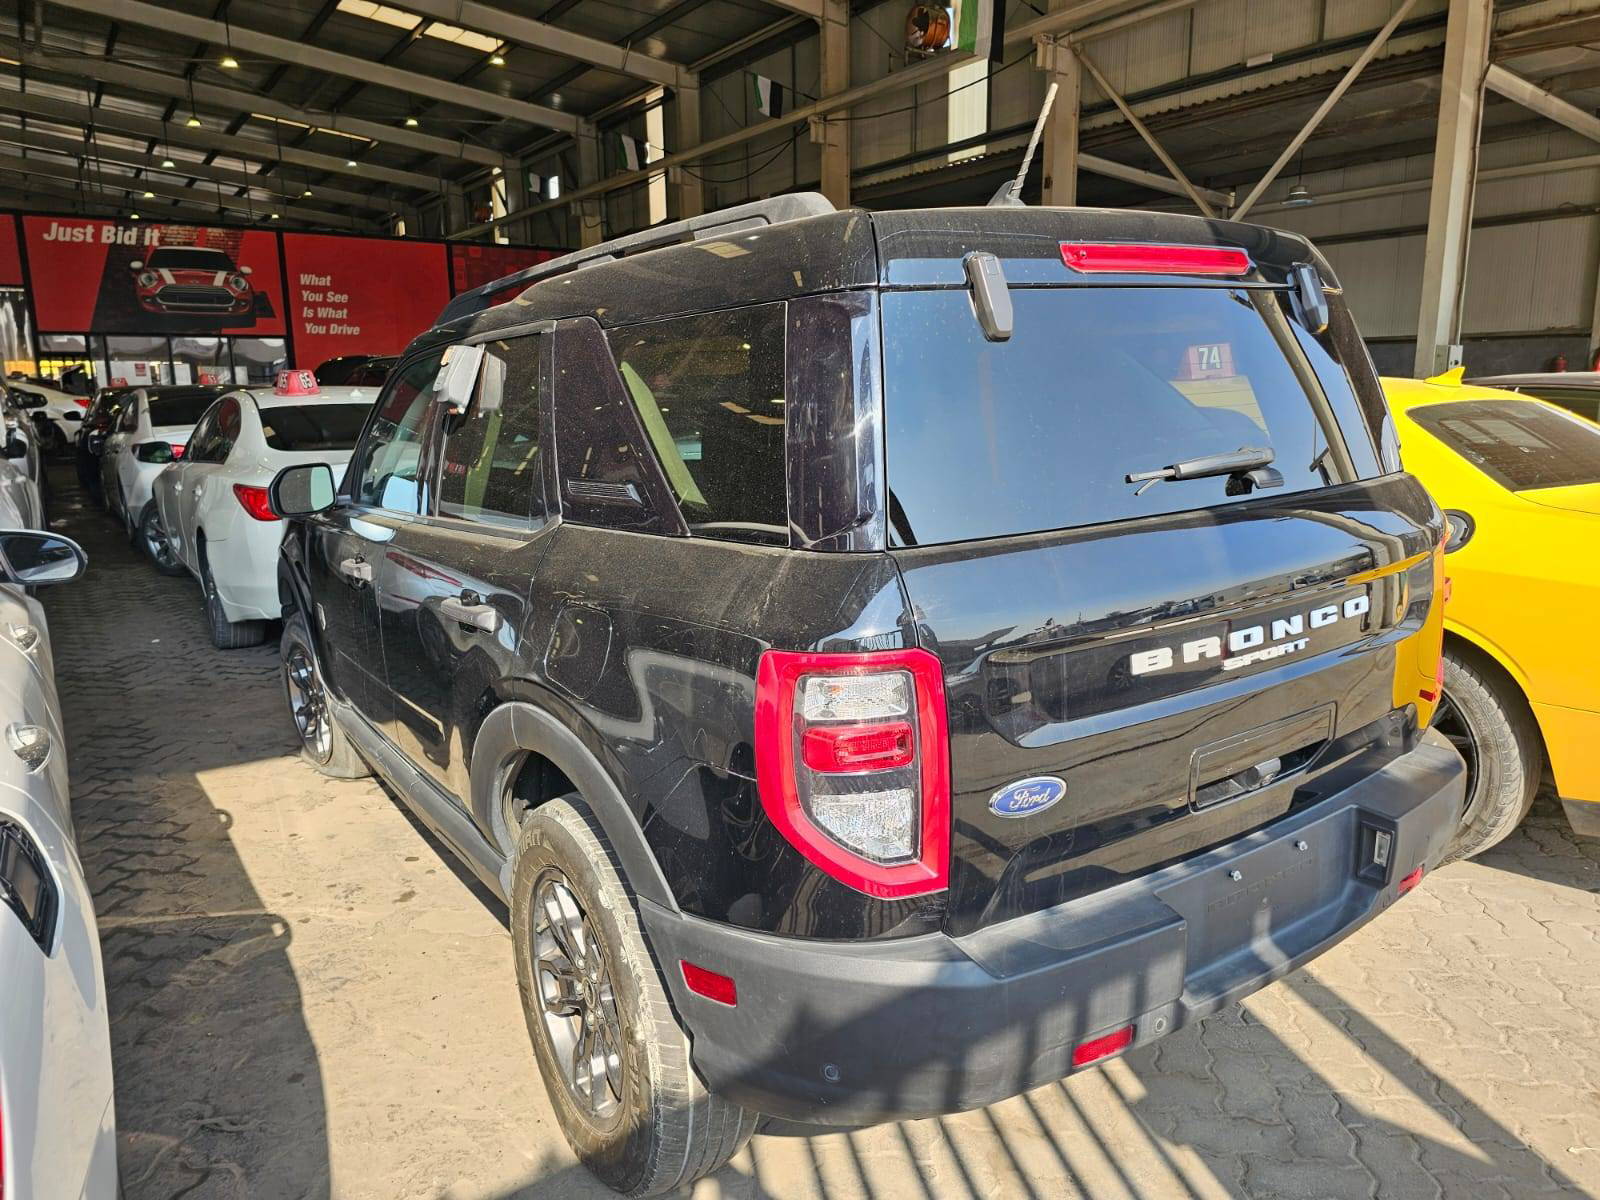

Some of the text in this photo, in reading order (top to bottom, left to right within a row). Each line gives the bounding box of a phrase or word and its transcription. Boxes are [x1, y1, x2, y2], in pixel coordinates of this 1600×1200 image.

[43, 222, 160, 247] Just Bid It
[300, 274, 331, 286] What
[302, 290, 349, 303] You See
[303, 306, 348, 319] Is What
[305, 323, 360, 336] You Drive
[1198, 346, 1221, 370] 74
[298, 371, 314, 389] 65
[1131, 595, 1370, 675] BRONCO
[1222, 637, 1311, 671] SPORT
[1009, 785, 1052, 811] Ford
